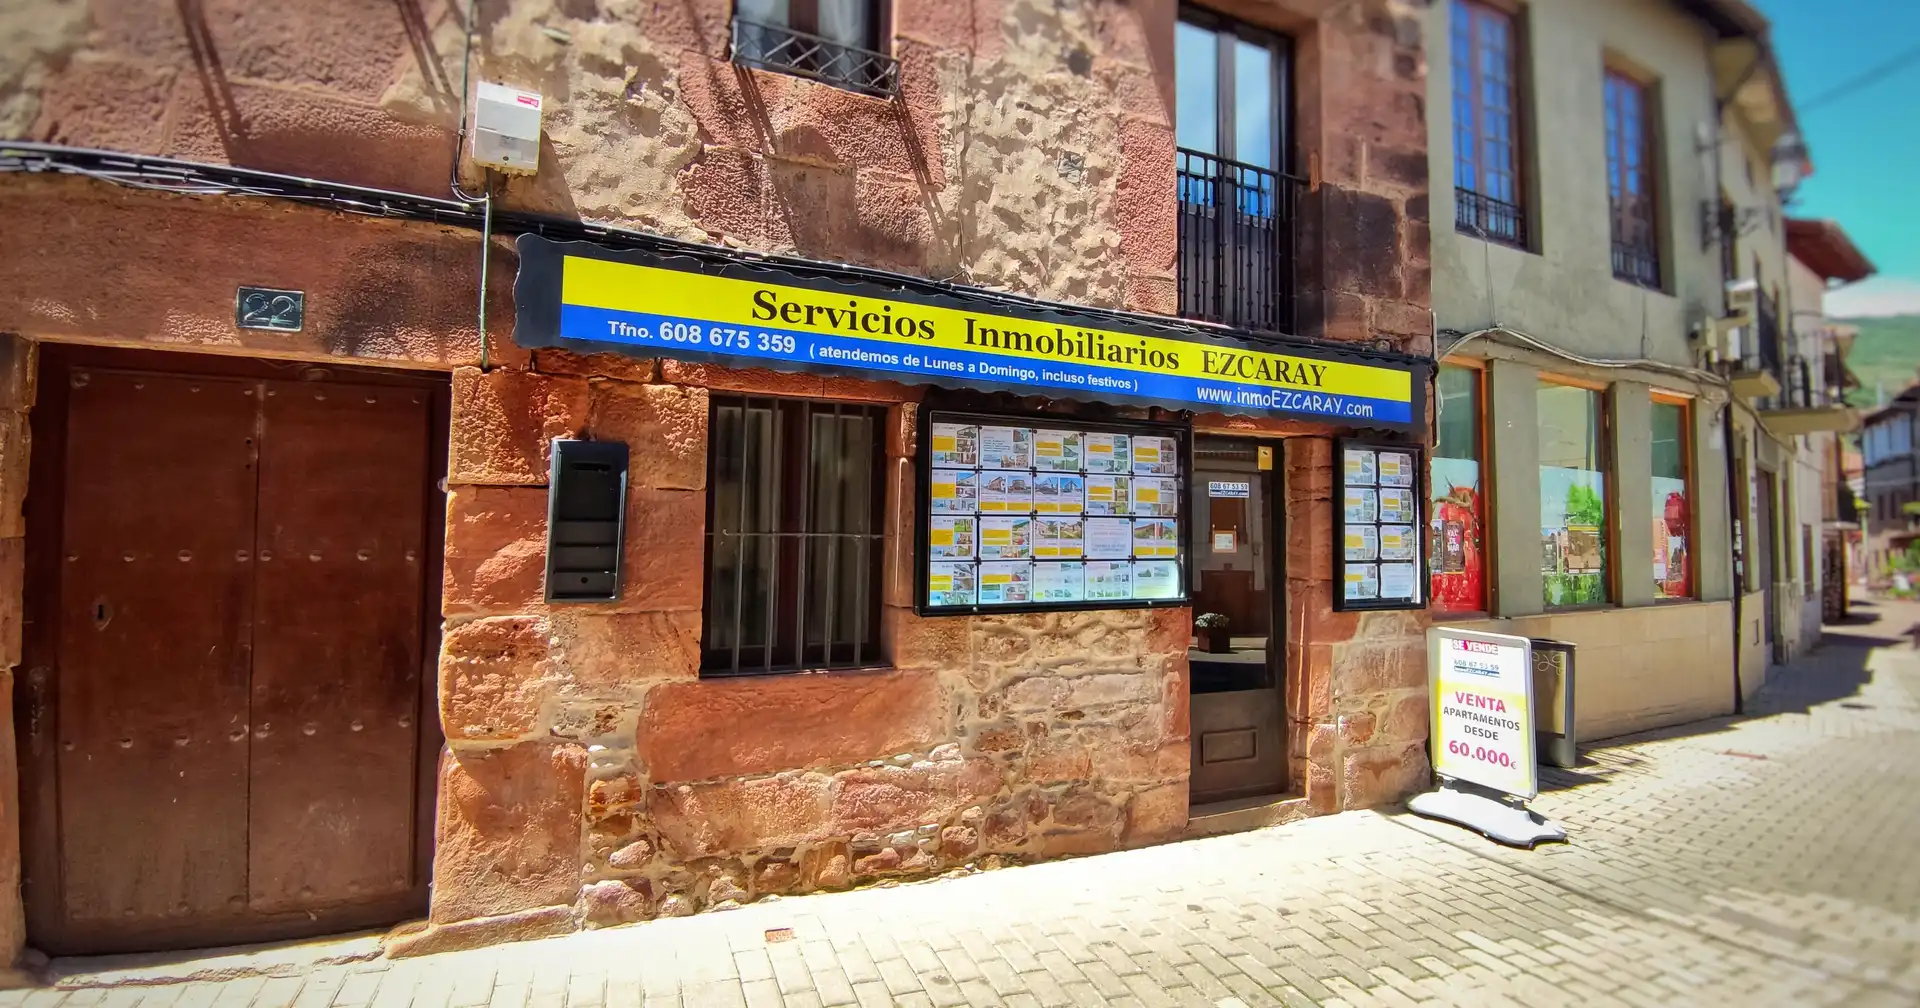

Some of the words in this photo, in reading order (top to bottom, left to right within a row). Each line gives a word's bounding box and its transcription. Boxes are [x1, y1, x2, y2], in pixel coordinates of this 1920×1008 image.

[243, 292, 297, 326] 22
[752, 289, 936, 341] Servicios
[964, 317, 1180, 371] Inmobiliarios
[1201, 349, 1328, 388] EZCARAY
[607, 320, 654, 339] Tfno.
[659, 321, 703, 345] 608
[709, 327, 751, 349] 675
[757, 332, 796, 354] 359
[818, 345, 900, 365] atendemos
[903, 353, 921, 367] de
[924, 355, 965, 373] Lunes
[967, 363, 976, 374] a
[979, 361, 1040, 382] Domingo,
[1042, 368, 1085, 385] incluso
[1087, 373, 1132, 390] festivos
[1196, 386, 1374, 418] www.inmoEZCARAY.com
[1210, 482, 1222, 490] 608
[1452, 639, 1464, 650] SE
[1467, 640, 1498, 655] VENDE
[1455, 691, 1507, 713] VENTA
[1443, 706, 1520, 731] APARTAMENTOS
[1464, 724, 1499, 741] DESDE
